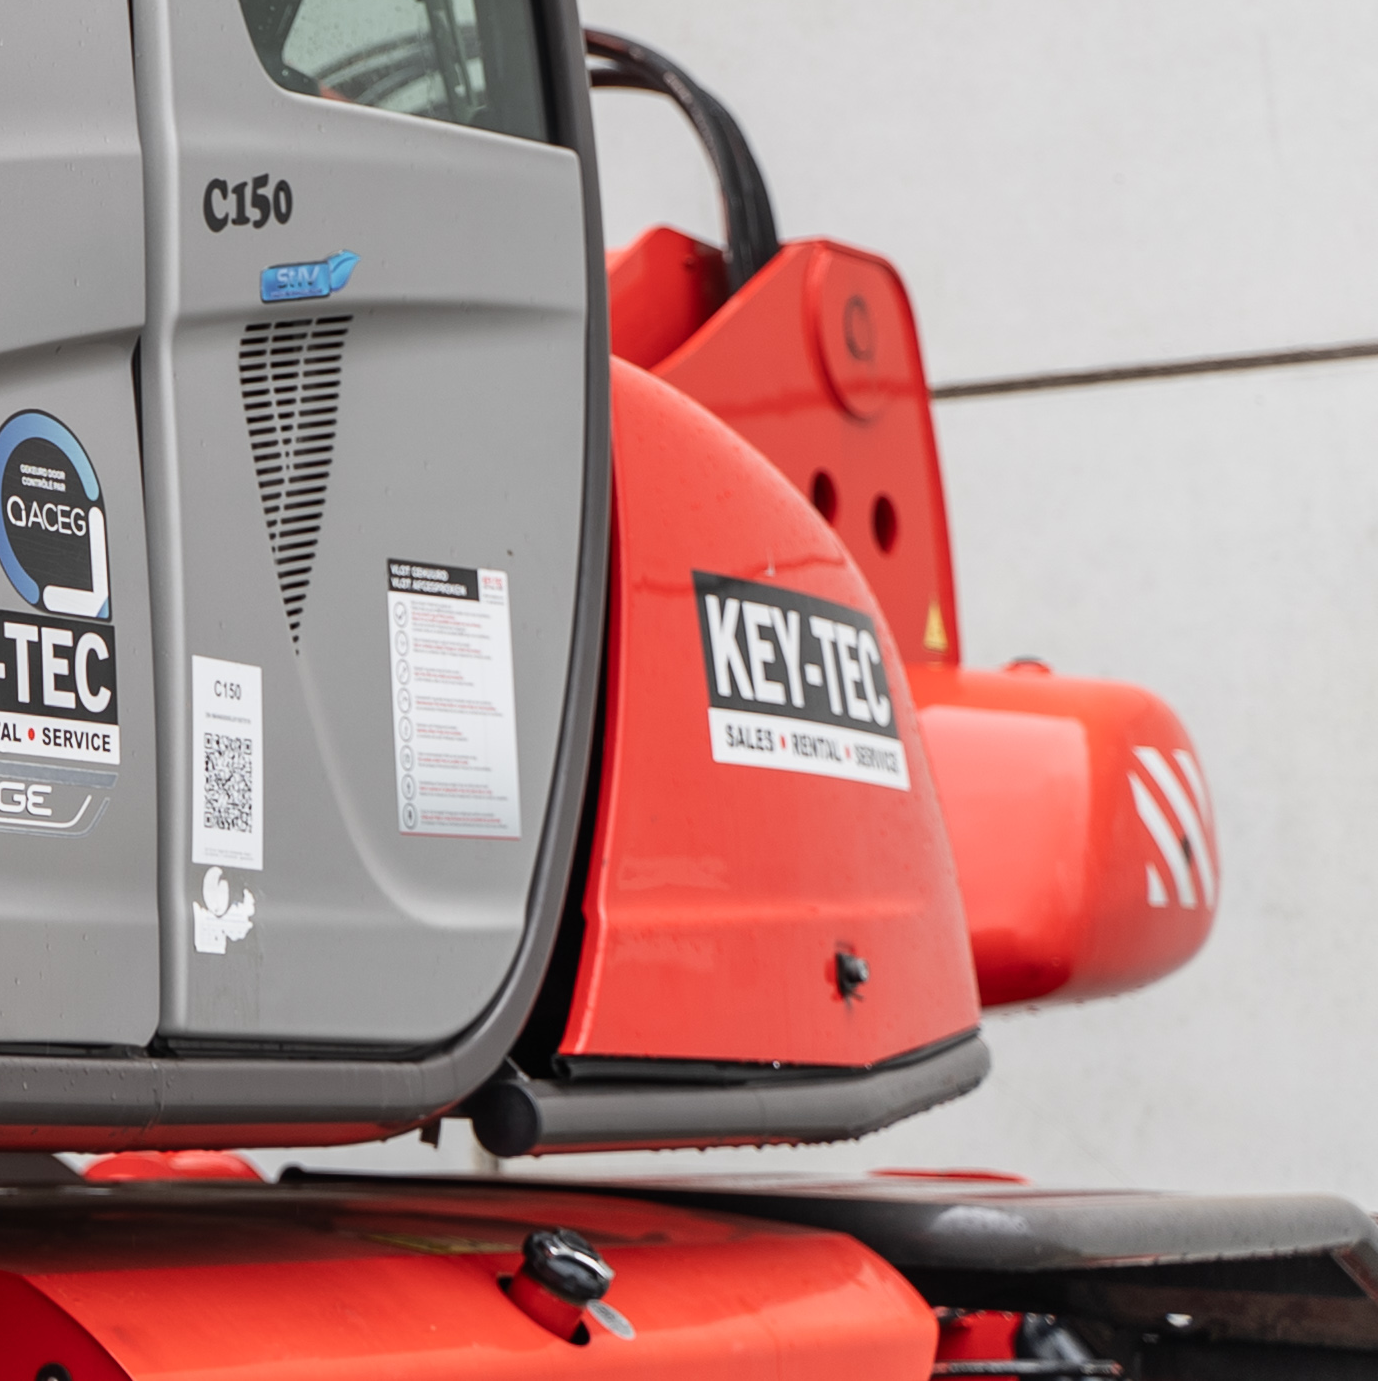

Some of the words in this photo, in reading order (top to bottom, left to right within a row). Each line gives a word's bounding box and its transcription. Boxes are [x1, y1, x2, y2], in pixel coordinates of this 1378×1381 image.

[202, 173, 294, 232] C150
[705, 593, 891, 728] KEY-TEC
[213, 680, 242, 701] C150
[41, 727, 112, 753] SERVICE
[725, 724, 775, 752] SALES
[791, 734, 843, 764] RENTAL
[854, 744, 900, 775] SERVICE
